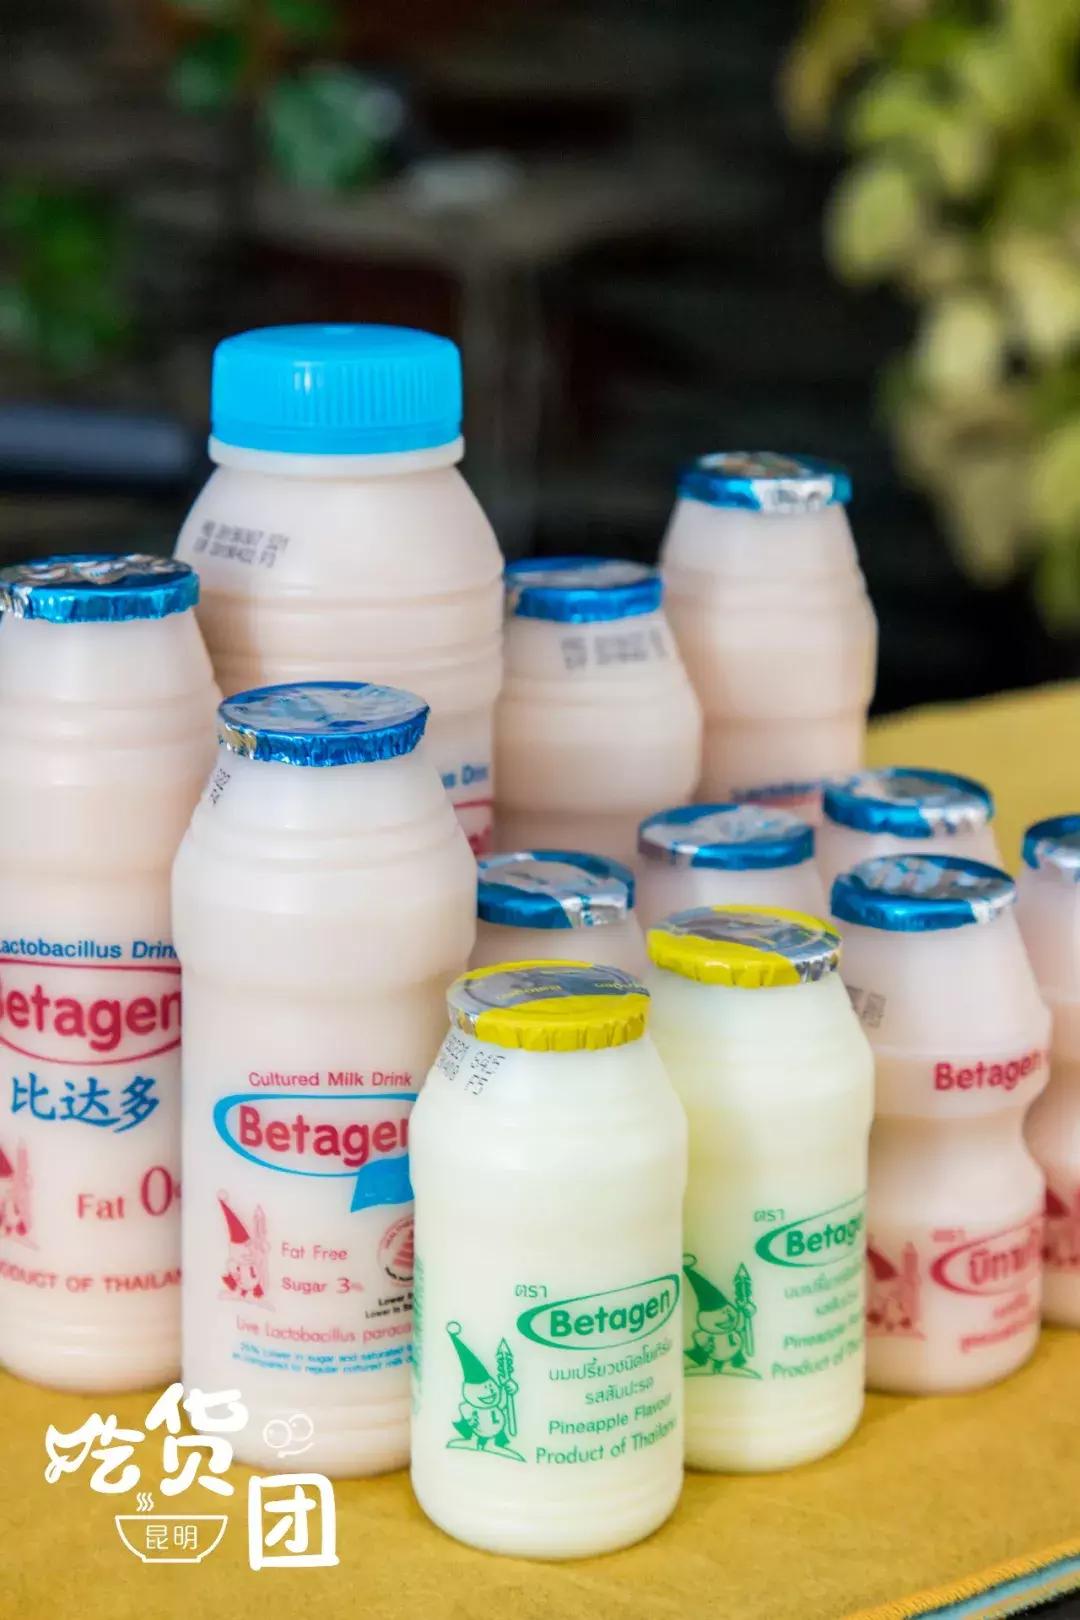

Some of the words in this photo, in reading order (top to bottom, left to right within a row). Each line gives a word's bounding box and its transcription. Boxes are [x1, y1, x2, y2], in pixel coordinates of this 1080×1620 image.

[0, 940, 122, 958] actobacillus
[0, 984, 182, 1052] etagen
[248, 1072, 320, 1088] Cultured
[327, 1071, 365, 1087] Milk
[372, 1071, 412, 1087] Drink
[11, 1072, 161, 1134] 比达多
[77, 1193, 125, 1220] Fat
[281, 1242, 305, 1258] Fat
[313, 1244, 348, 1261] Free
[0, 1261, 57, 1288] ODUCT
[65, 1276, 93, 1293] OF
[281, 1276, 327, 1295] Sugar
[549, 1289, 671, 1338] Betagen
[266, 1321, 356, 1343] Lactobacillus
[548, 1413, 629, 1435] Pineapple
[536, 1444, 605, 1465] Product
[610, 1436, 627, 1459] of
